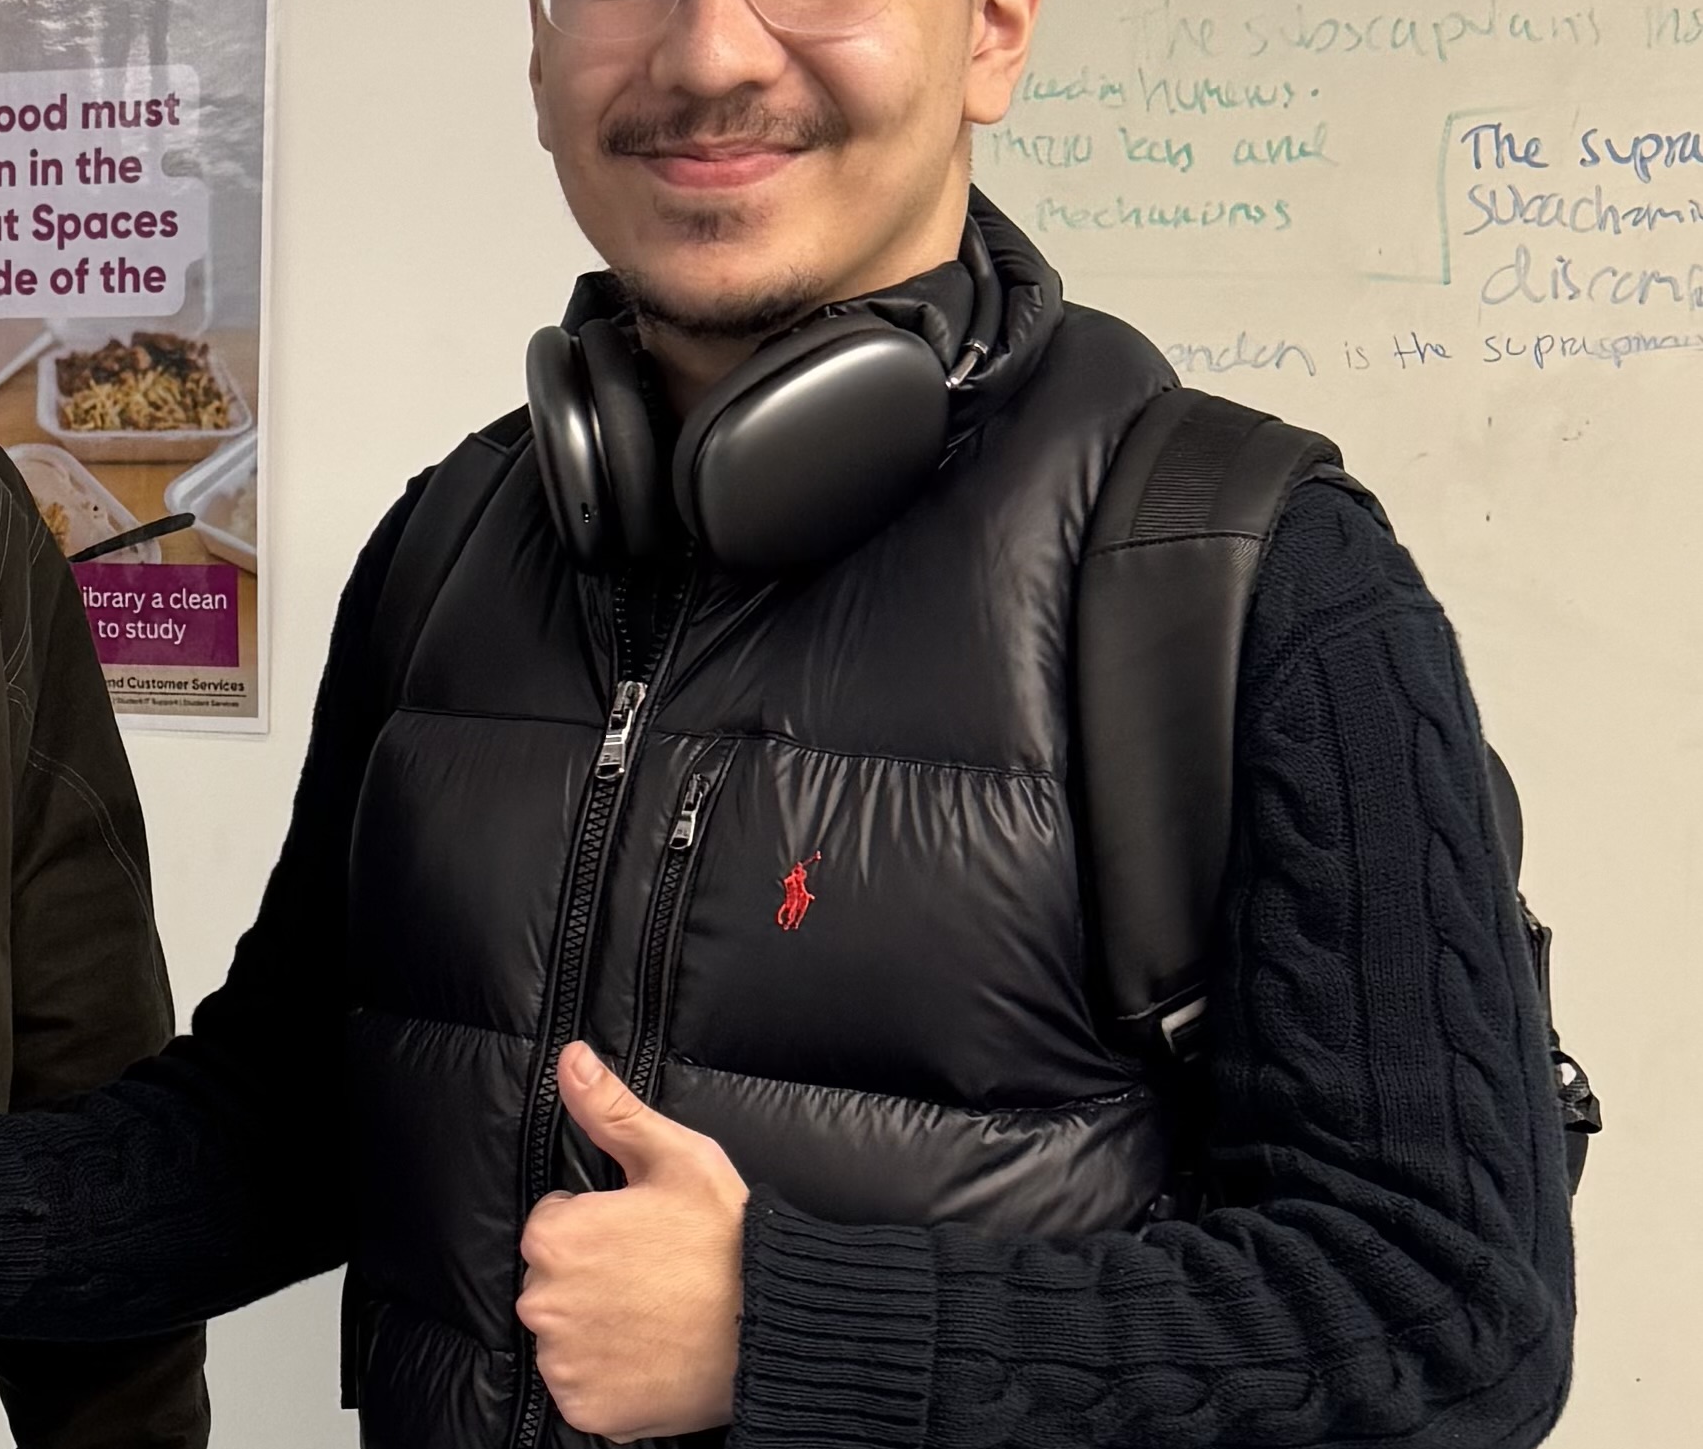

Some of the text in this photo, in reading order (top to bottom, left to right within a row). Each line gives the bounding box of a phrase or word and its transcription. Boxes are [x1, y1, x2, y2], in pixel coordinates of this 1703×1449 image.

[80, 91, 181, 130] must
[1459, 121, 1550, 170] The
[29, 149, 64, 188] in
[75, 147, 143, 186] the
[31, 203, 180, 250] Spaces
[49, 257, 91, 295] of
[99, 257, 167, 294] the
[1343, 340, 1371, 370] is
[1392, 330, 1453, 370] the
[81, 585, 228, 615] ibrary a clean
[97, 618, 187, 645] to study
[127, 676, 189, 691] Customer
[191, 678, 245, 692] Services
